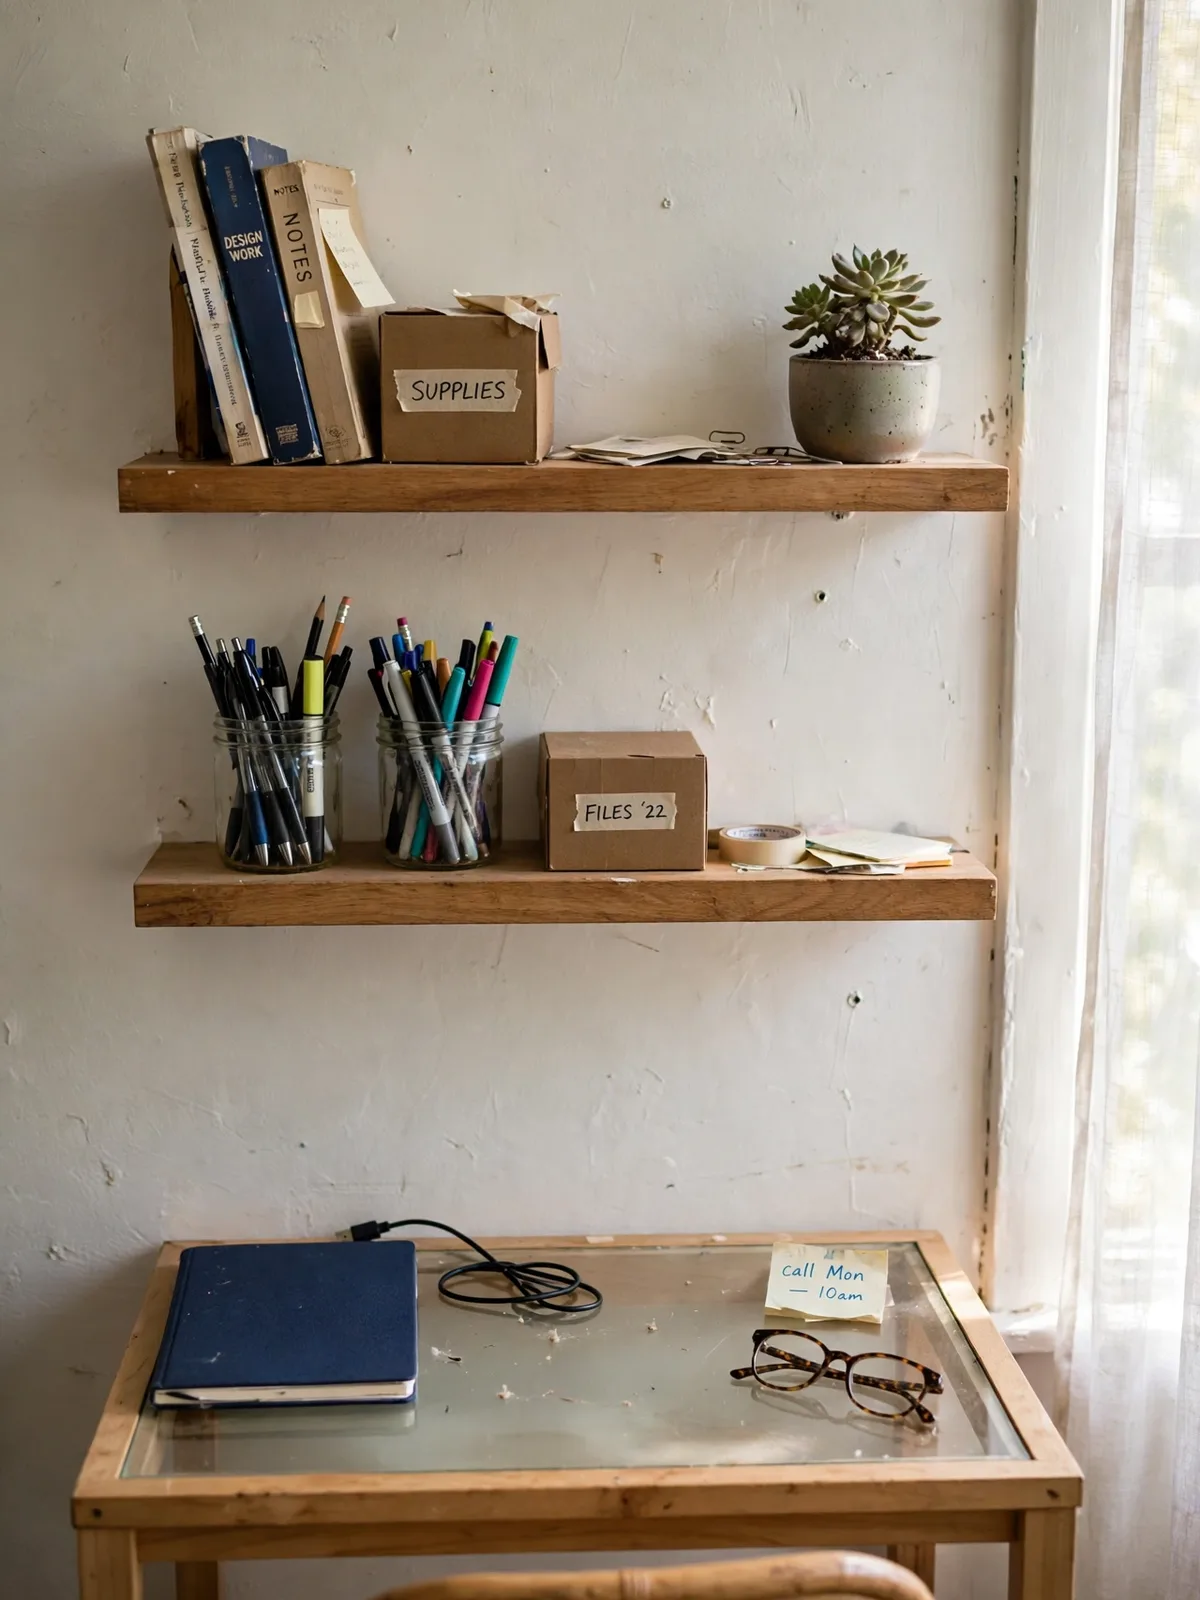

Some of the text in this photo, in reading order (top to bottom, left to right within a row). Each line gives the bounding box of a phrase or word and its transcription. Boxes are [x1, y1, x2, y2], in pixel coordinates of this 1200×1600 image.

[273, 184, 300, 195] NOTES
[223, 230, 264, 250] DESIGN
[283, 212, 313, 283] NOTES
[228, 245, 264, 262] WORK
[411, 379, 506, 401] SUPPLIES
[585, 801, 667, 822] FILES '22
[826, 1264, 864, 1281] Mon
[819, 1285, 863, 1301] 10am
